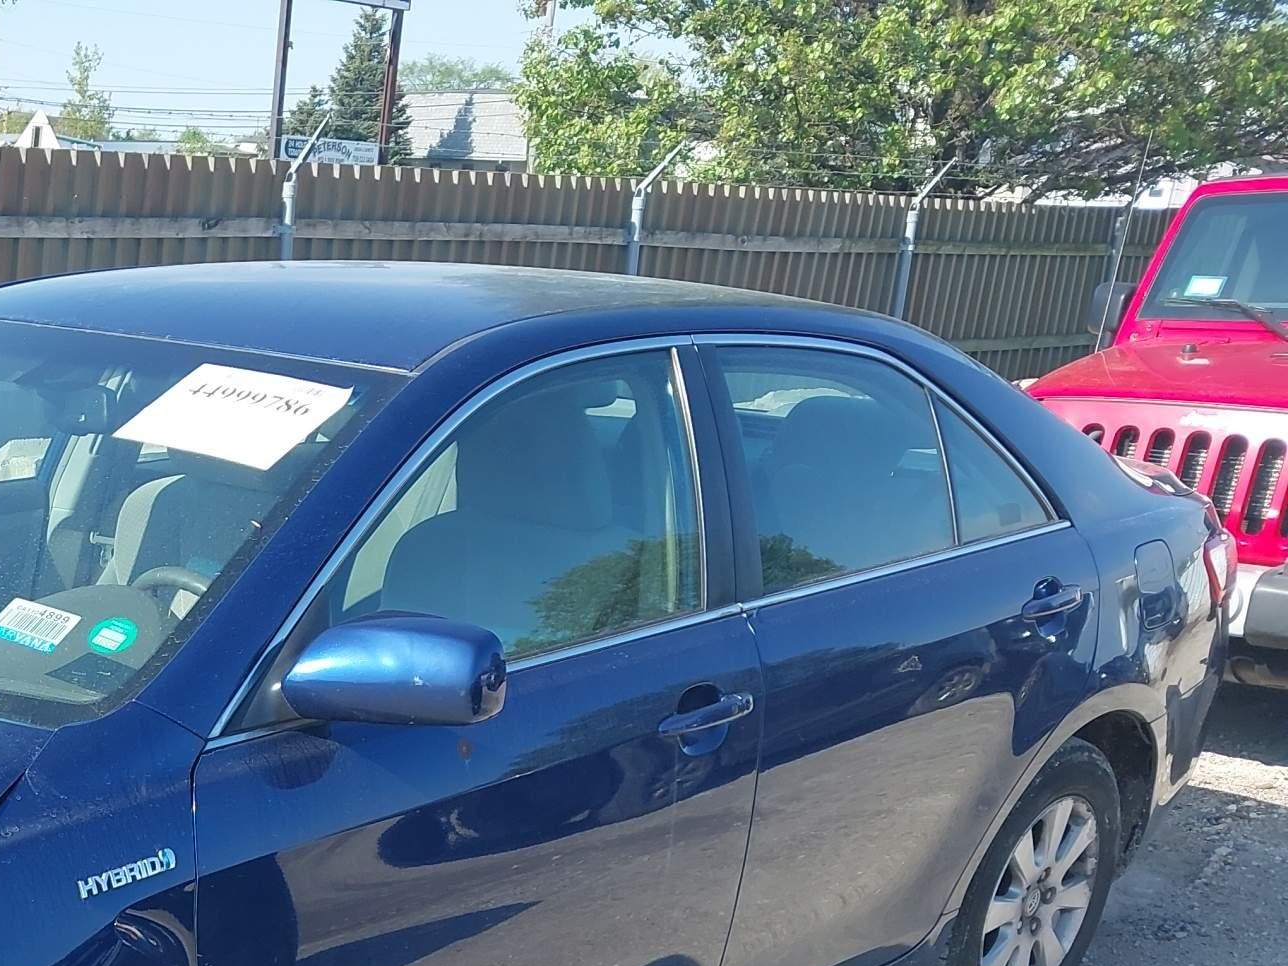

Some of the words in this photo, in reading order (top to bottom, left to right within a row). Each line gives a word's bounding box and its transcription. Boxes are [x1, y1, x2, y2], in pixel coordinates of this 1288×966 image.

[312, 141, 353, 160] PETERSON
[189, 383, 312, 416] 44999786
[77, 857, 165, 900] HYBRID
